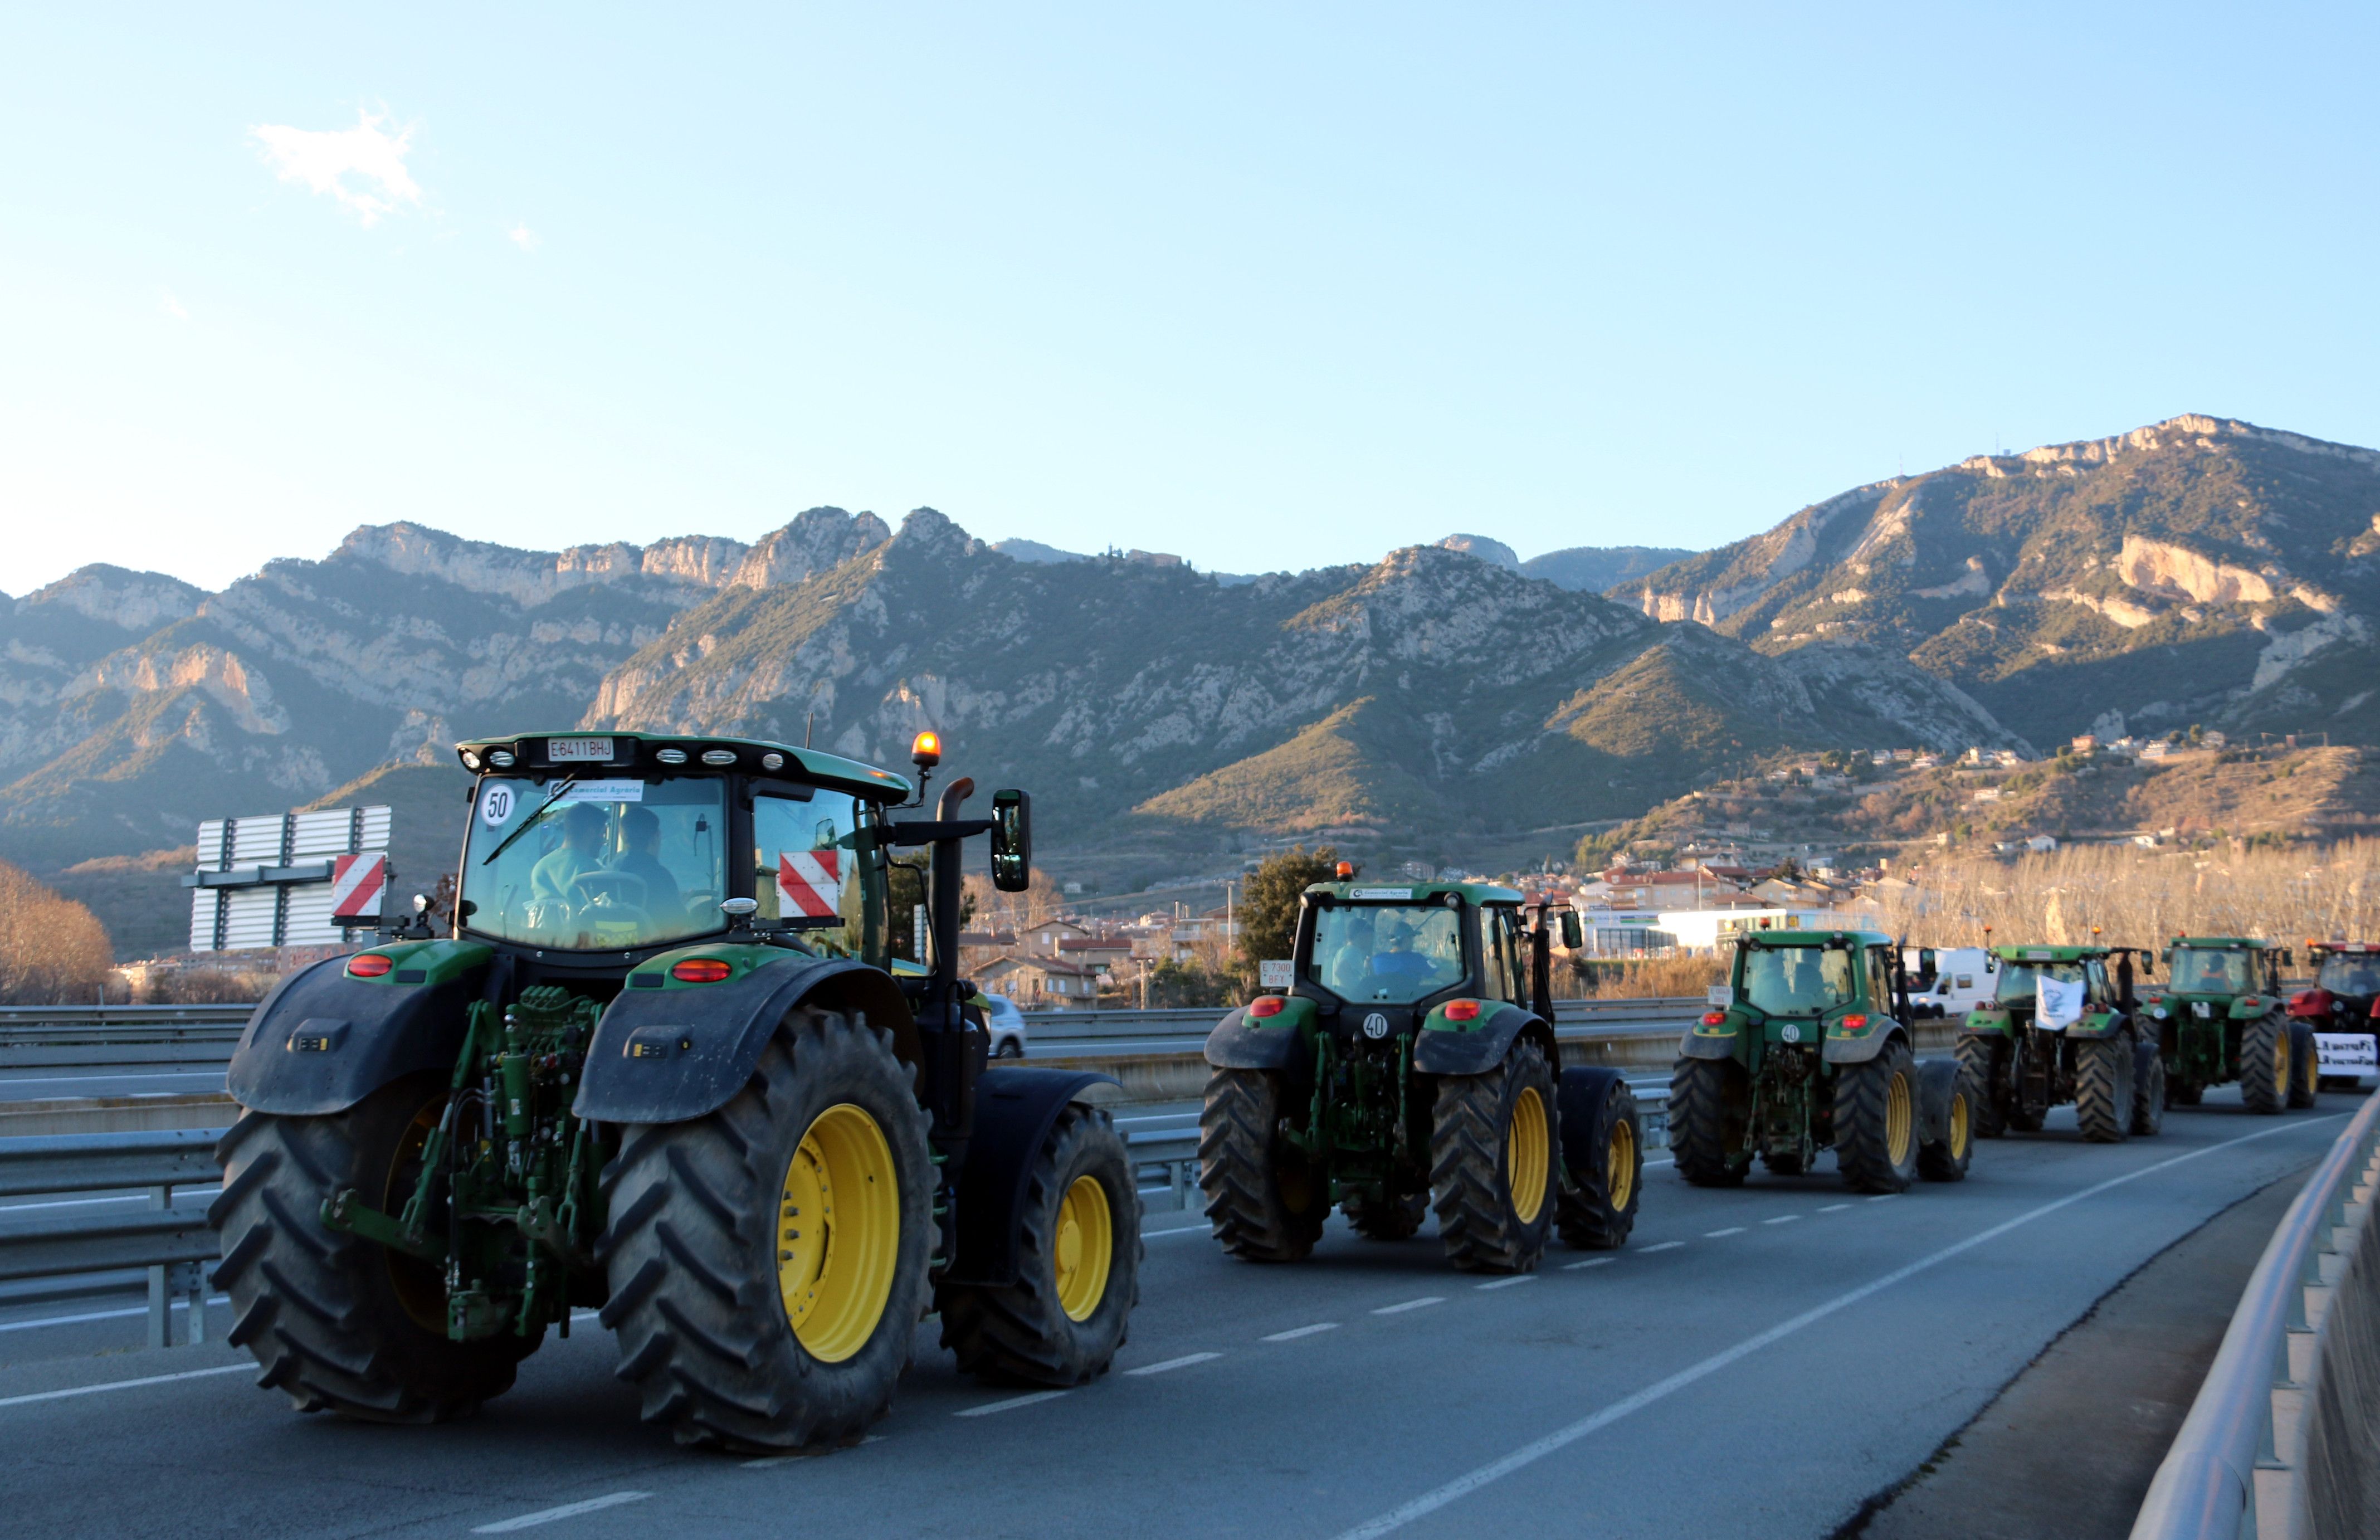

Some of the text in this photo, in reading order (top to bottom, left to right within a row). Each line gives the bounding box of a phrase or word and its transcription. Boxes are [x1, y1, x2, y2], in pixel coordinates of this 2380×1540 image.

[551, 742, 611, 756] E6411BHJ
[488, 792, 508, 818] 50
[1262, 963, 1291, 972] E 7300
[1269, 974, 1284, 984] BFY
[1366, 1015, 1383, 1036] 40
[1783, 1026, 1797, 1041] 40
